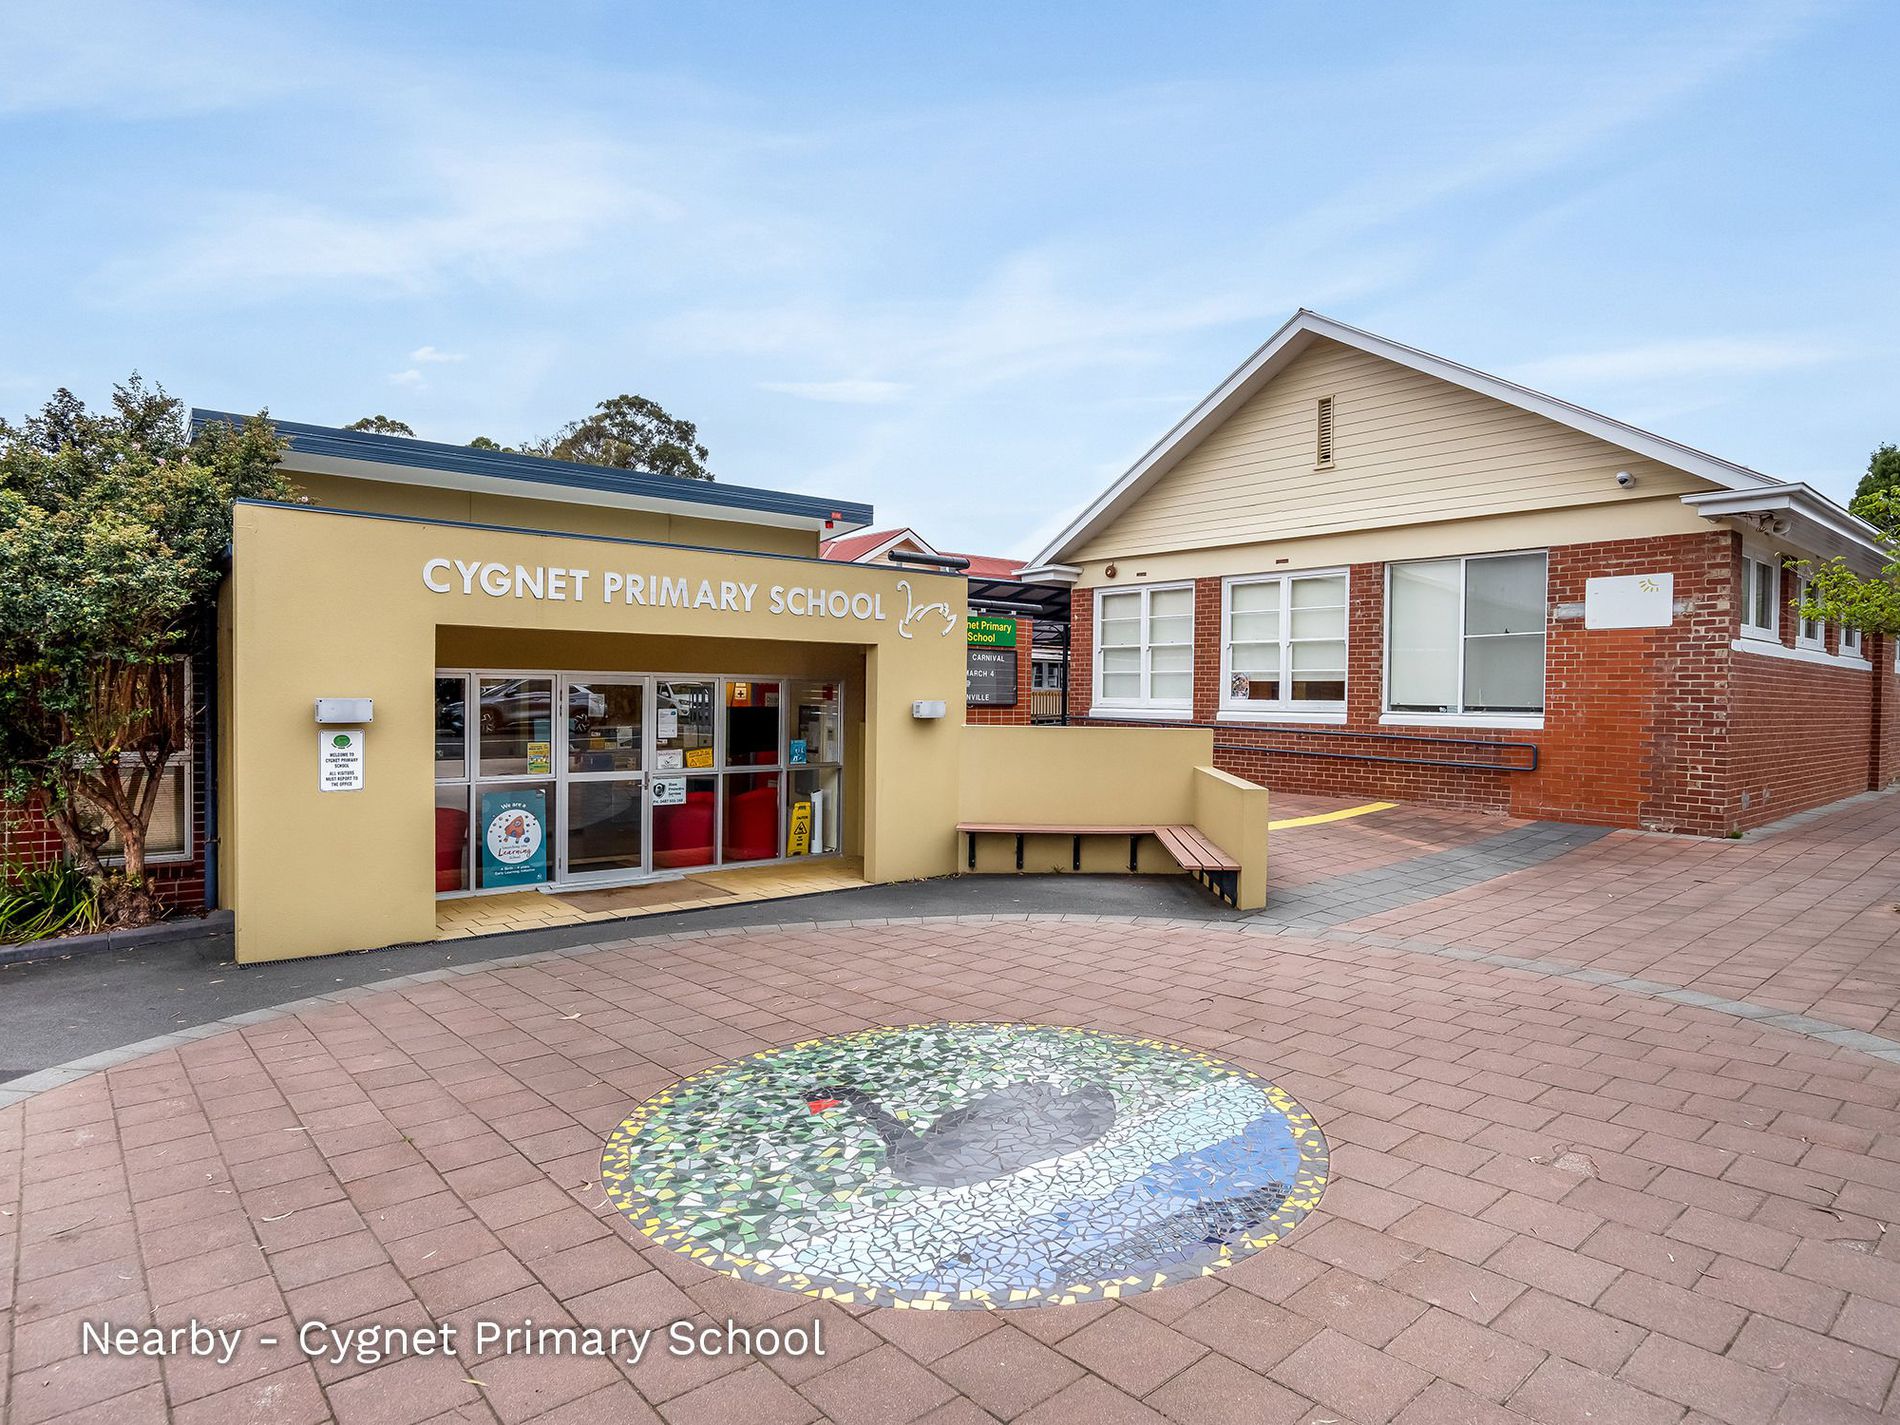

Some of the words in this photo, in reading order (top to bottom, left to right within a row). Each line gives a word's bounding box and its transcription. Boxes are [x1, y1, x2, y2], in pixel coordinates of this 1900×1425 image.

[422, 557, 590, 602] CYGNET
[603, 572, 759, 612] PRIMARY
[768, 585, 887, 621] SCHOOL
[981, 620, 1012, 634] Primary
[967, 631, 996, 643] School
[972, 653, 1005, 662] CARNIVAL
[498, 847, 532, 857] Learning
